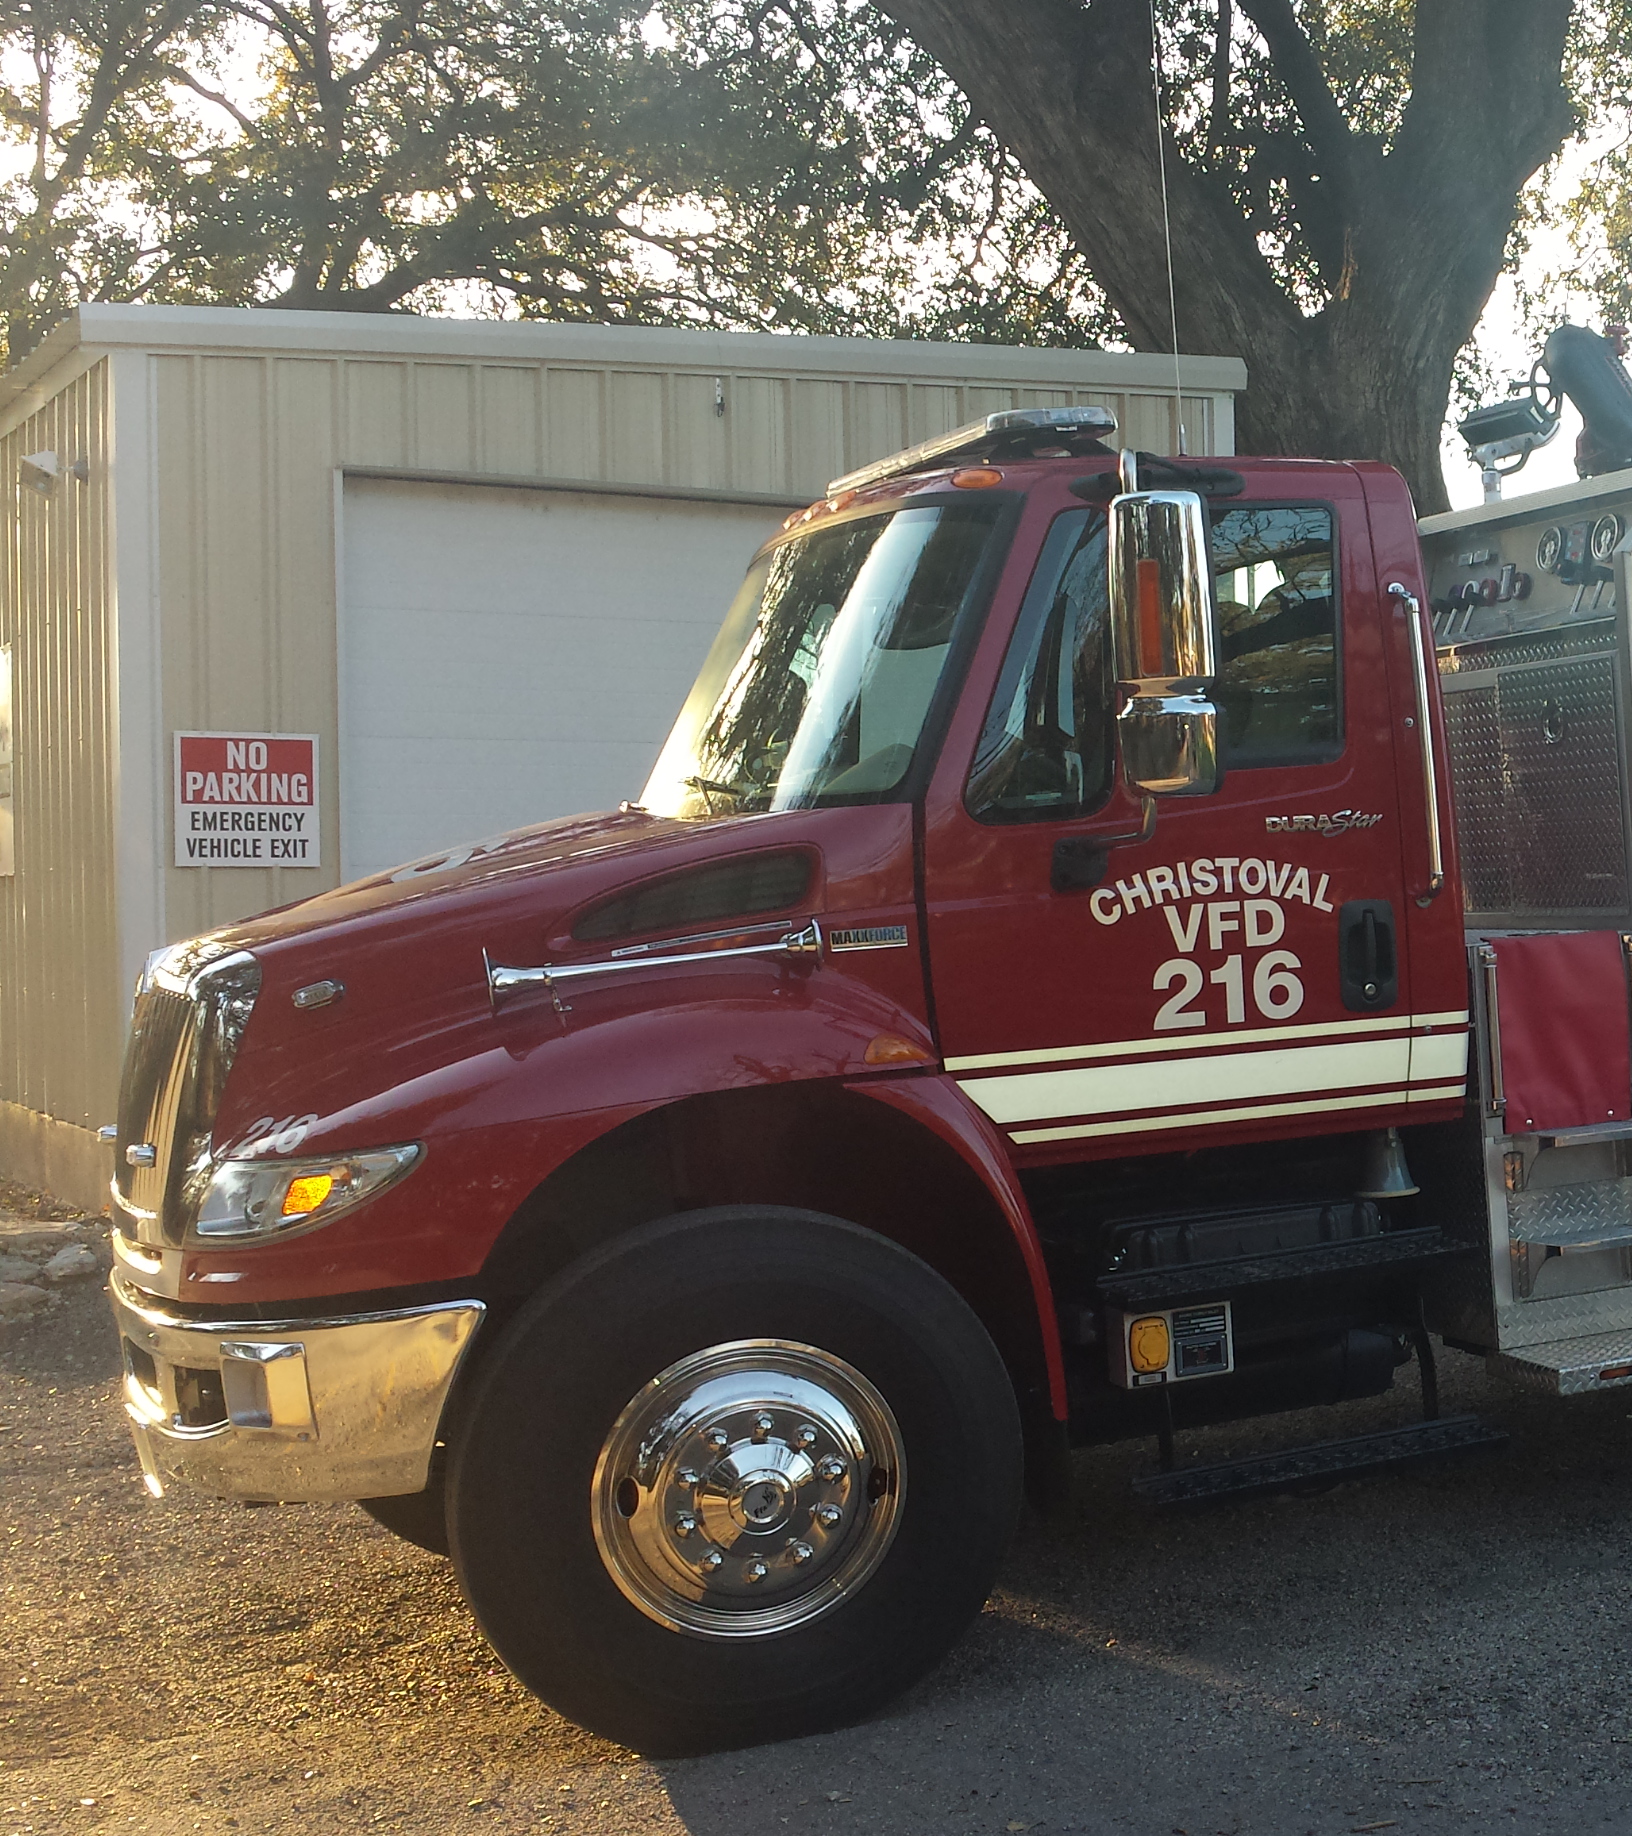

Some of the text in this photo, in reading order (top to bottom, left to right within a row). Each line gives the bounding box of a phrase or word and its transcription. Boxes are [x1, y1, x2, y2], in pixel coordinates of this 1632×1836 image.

[226, 741, 268, 770] NO
[185, 771, 308, 803] PARKING
[190, 811, 305, 832] EMERGENCY
[186, 837, 309, 859] VEHICLE EXIT
[1089, 857, 1334, 926] CHRISTOVAL
[1162, 898, 1285, 953] VFD
[1152, 950, 1304, 1031] 216
[228, 1113, 319, 1160] 216
